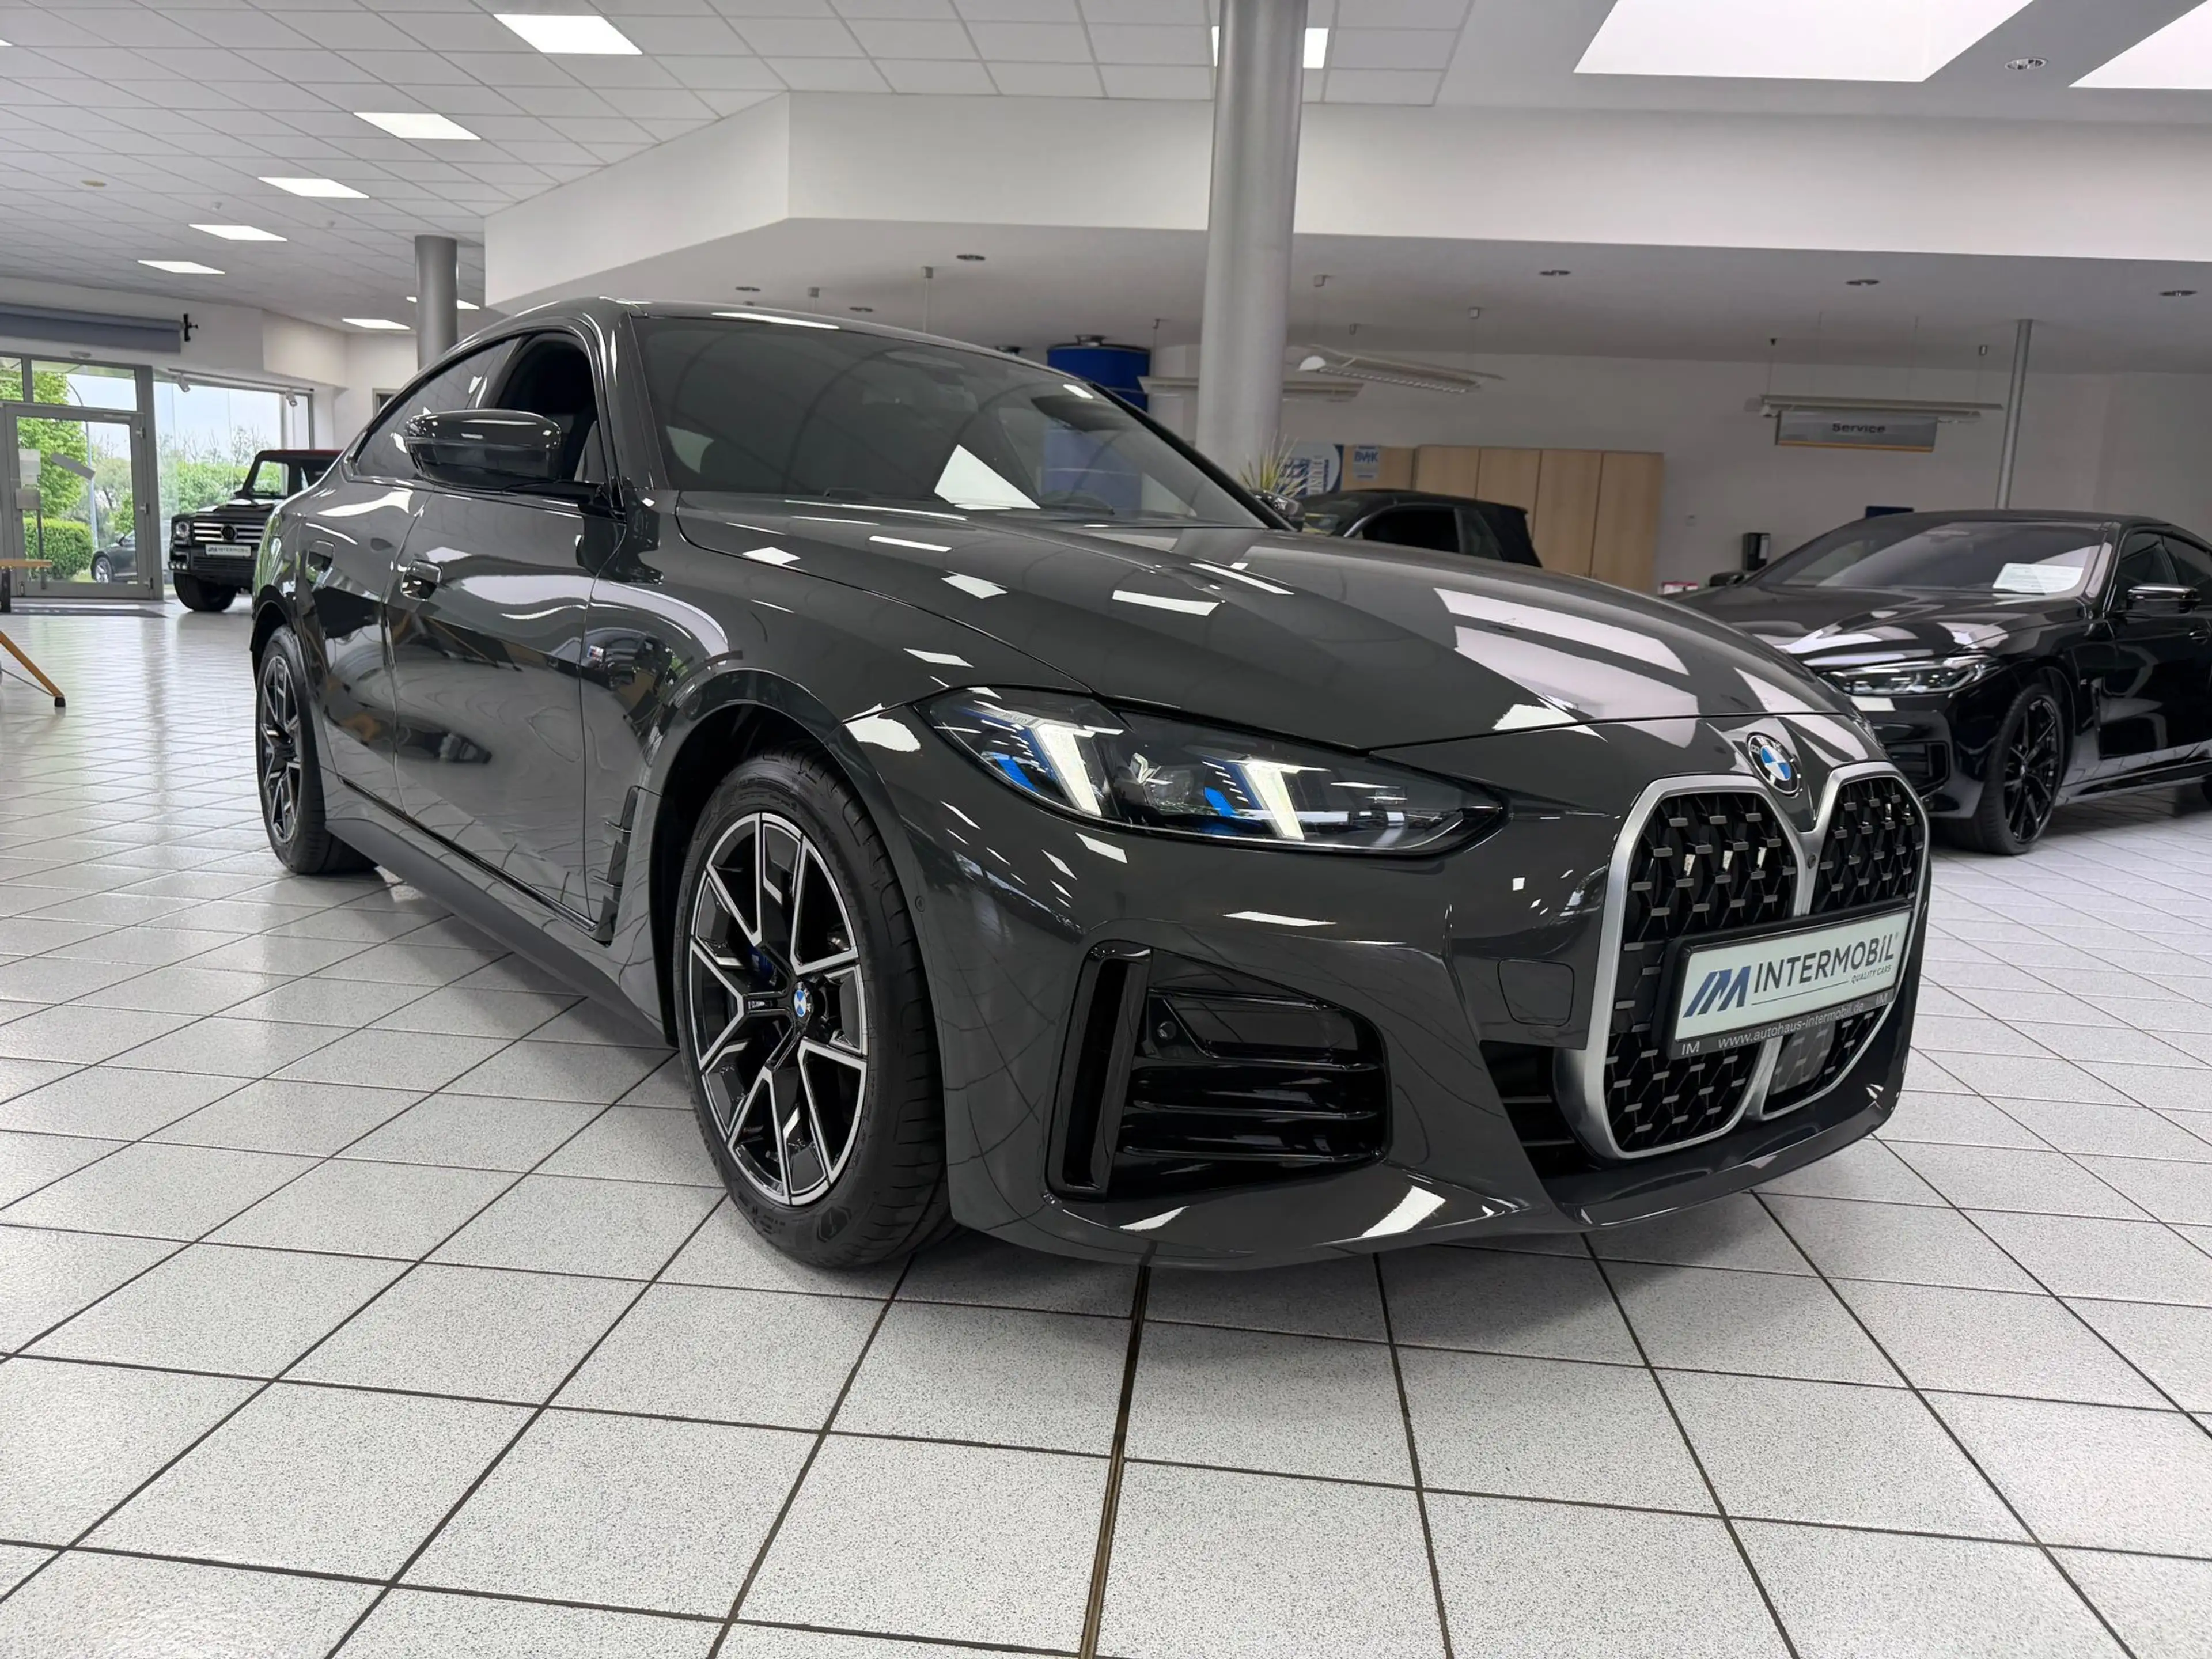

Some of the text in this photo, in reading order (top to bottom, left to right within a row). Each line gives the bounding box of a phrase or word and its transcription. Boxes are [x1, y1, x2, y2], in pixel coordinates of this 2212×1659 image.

[1832, 422, 1886, 434] Service
[1753, 933, 1895, 994] INTERMOBIL
[1851, 964, 1892, 984] QUALITY CARS
[1681, 1040, 1701, 1056] IM
[1717, 1001, 1864, 1049] www.autohaus-intermobil.de
